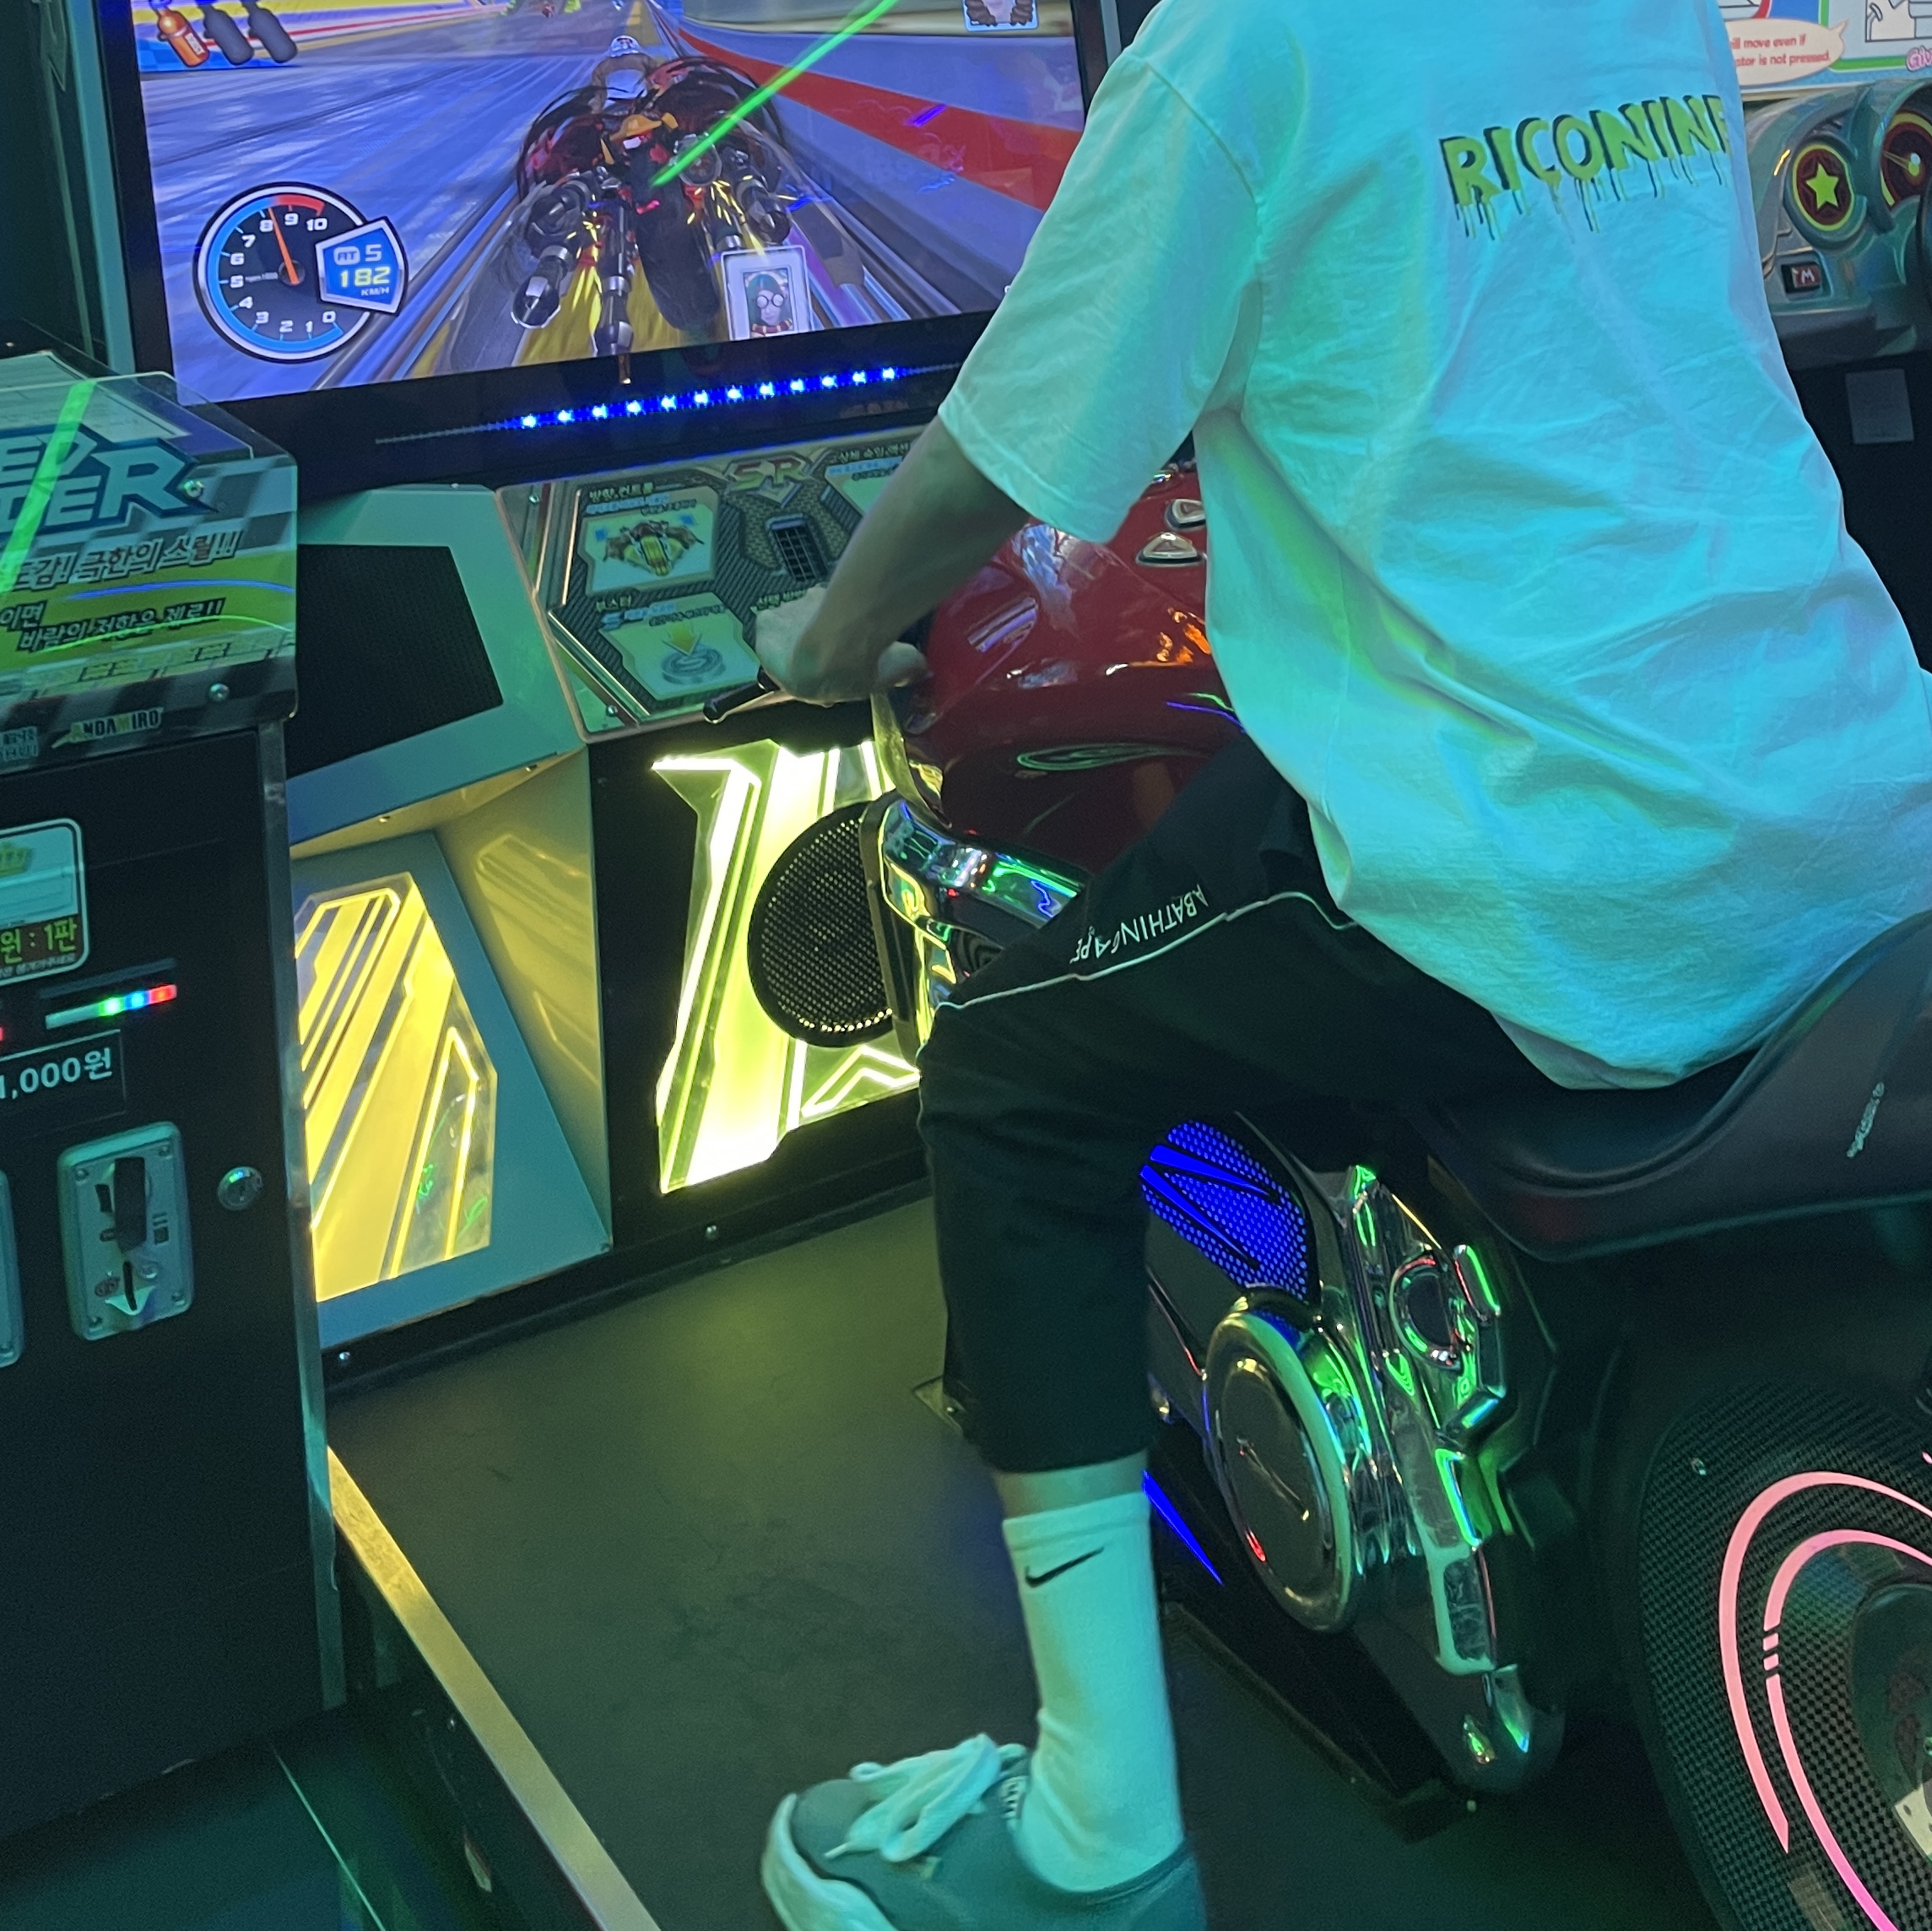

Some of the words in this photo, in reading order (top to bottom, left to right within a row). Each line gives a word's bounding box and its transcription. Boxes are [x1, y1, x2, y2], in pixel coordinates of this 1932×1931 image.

[1744, 39, 1770, 48] move
[1773, 37, 1796, 47] even
[1759, 54, 1767, 65] is
[1770, 53, 1786, 64] not
[260, 219, 273, 232] 8
[284, 213, 298, 225] 9
[306, 218, 327, 231] 10
[241, 234, 256, 247] 7
[230, 252, 244, 265] 6
[365, 244, 382, 262] 5
[230, 275, 244, 288] 5
[340, 266, 391, 288] 182
[1801, 268, 1816, 284] M
[239, 296, 253, 309] 4
[256, 311, 269, 323] 3
[322, 311, 336, 322] 0
[279, 321, 293, 333] 2
[306, 321, 313, 332] 1
[76, 538, 163, 581] 극한의
